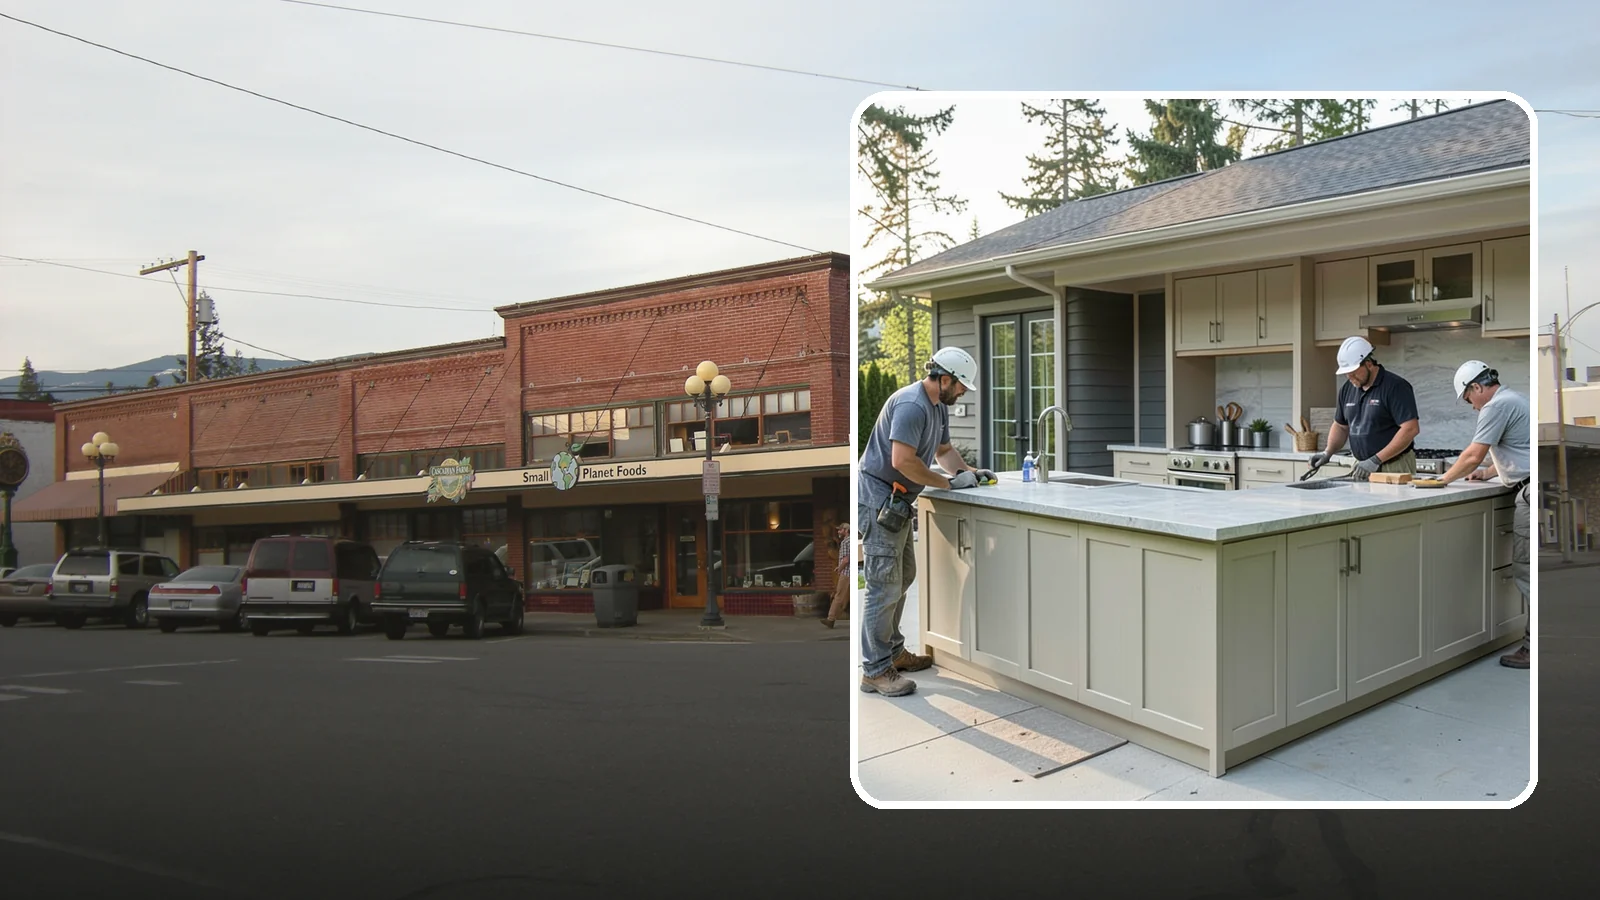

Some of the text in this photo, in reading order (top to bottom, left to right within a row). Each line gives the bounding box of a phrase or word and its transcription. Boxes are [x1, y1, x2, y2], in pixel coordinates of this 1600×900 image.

[523, 464, 647, 483] Small Planet Foods
